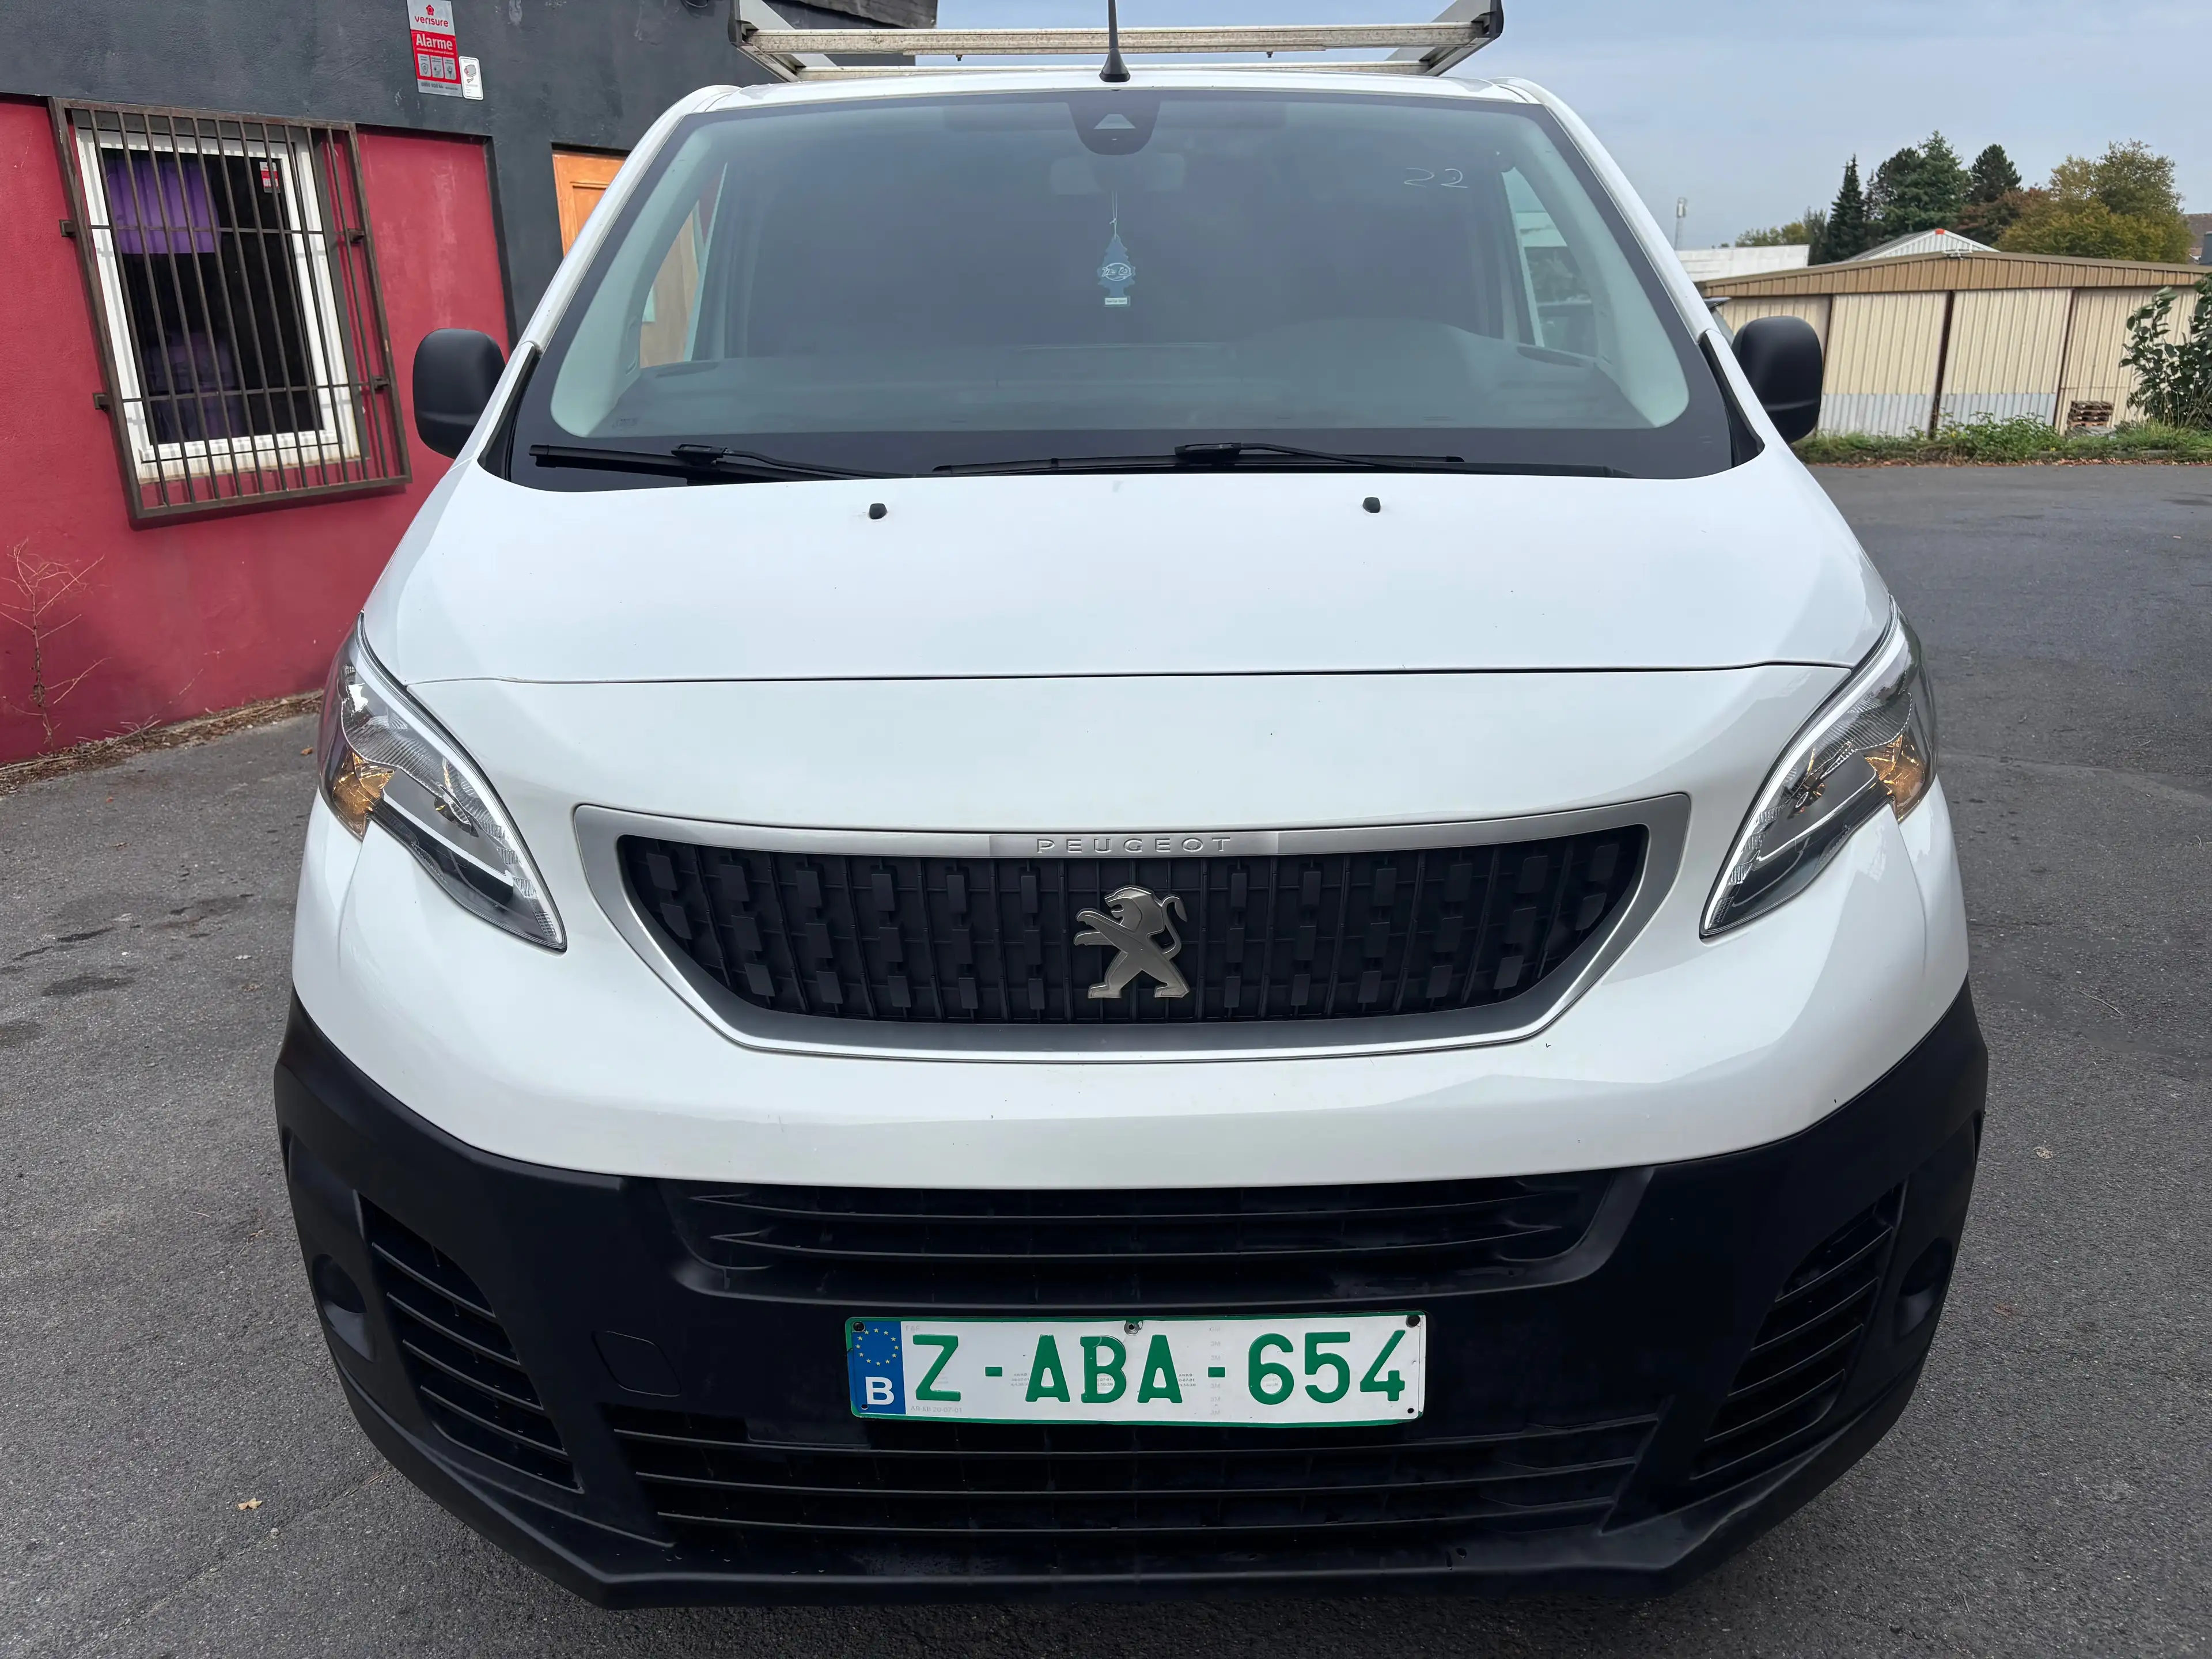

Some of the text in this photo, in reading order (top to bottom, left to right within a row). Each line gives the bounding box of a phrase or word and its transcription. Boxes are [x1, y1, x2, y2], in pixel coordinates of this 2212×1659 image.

[414, 16, 449, 27] verisure
[416, 33, 453, 50] Alarme
[1404, 168, 1468, 188] 22
[1036, 837, 1231, 853] PEUGEOT
[865, 1376, 895, 1405] B
